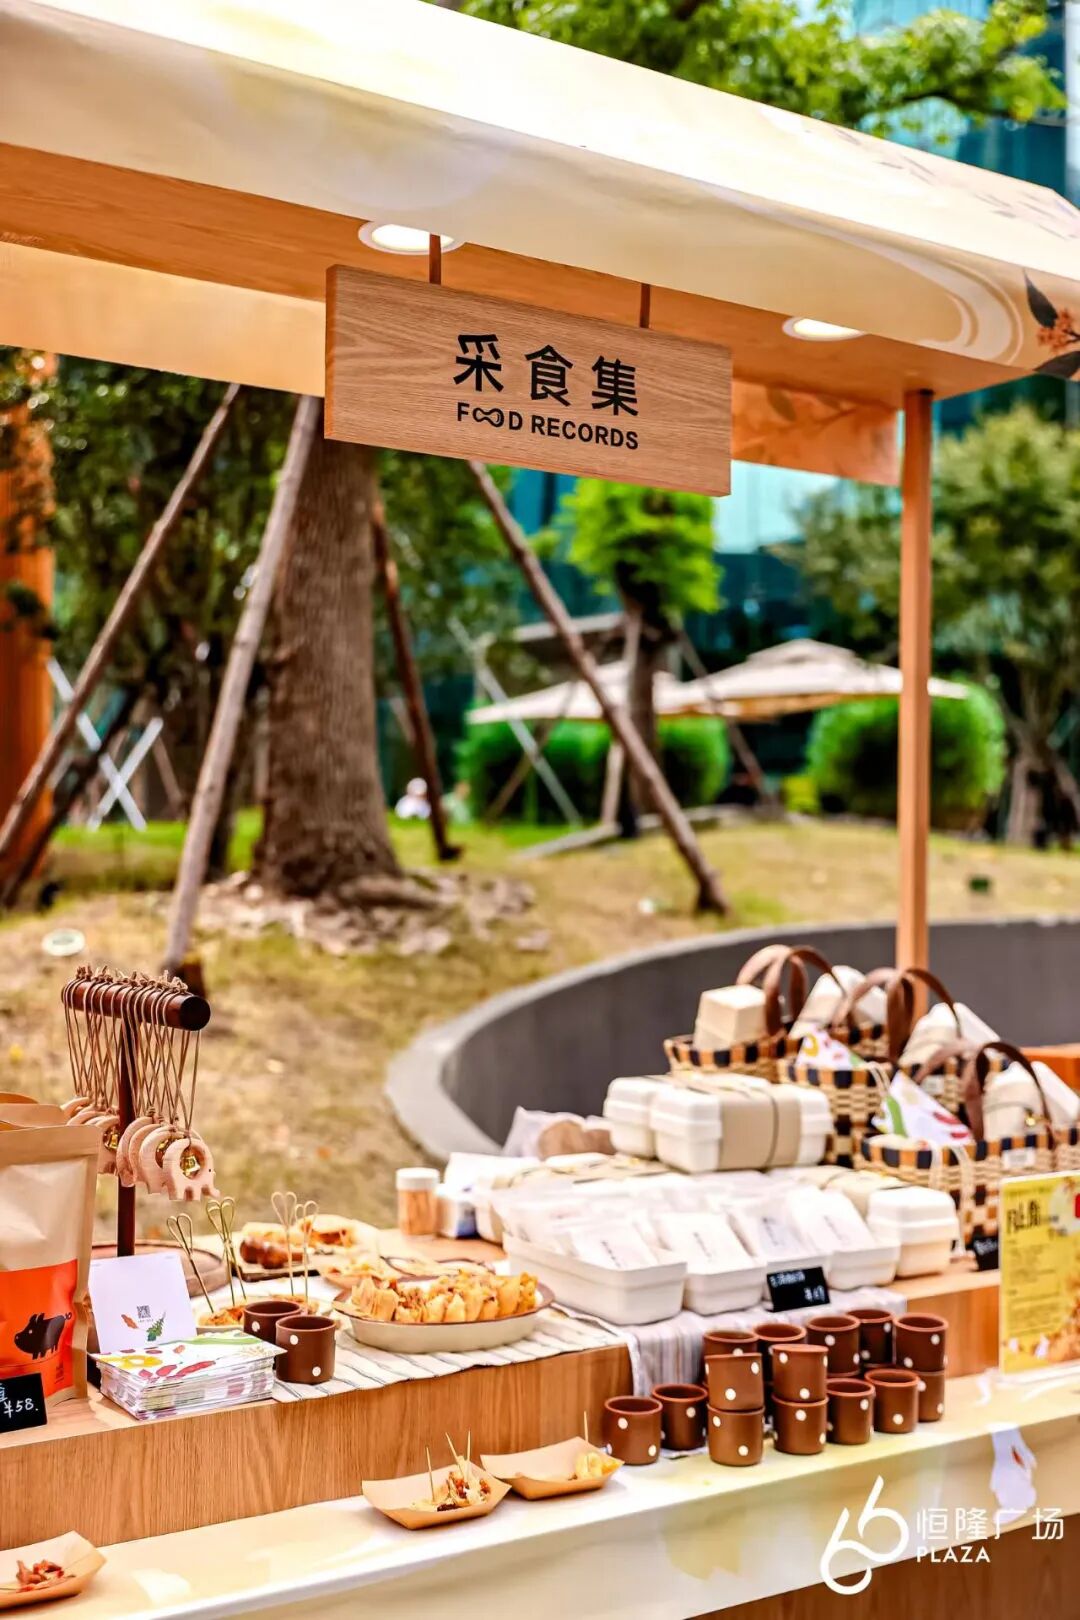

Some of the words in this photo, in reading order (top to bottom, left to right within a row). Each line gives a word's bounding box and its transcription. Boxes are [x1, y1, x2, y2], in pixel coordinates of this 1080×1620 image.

[453, 334, 639, 416] 采食集
[531, 414, 639, 450] RECORDS
